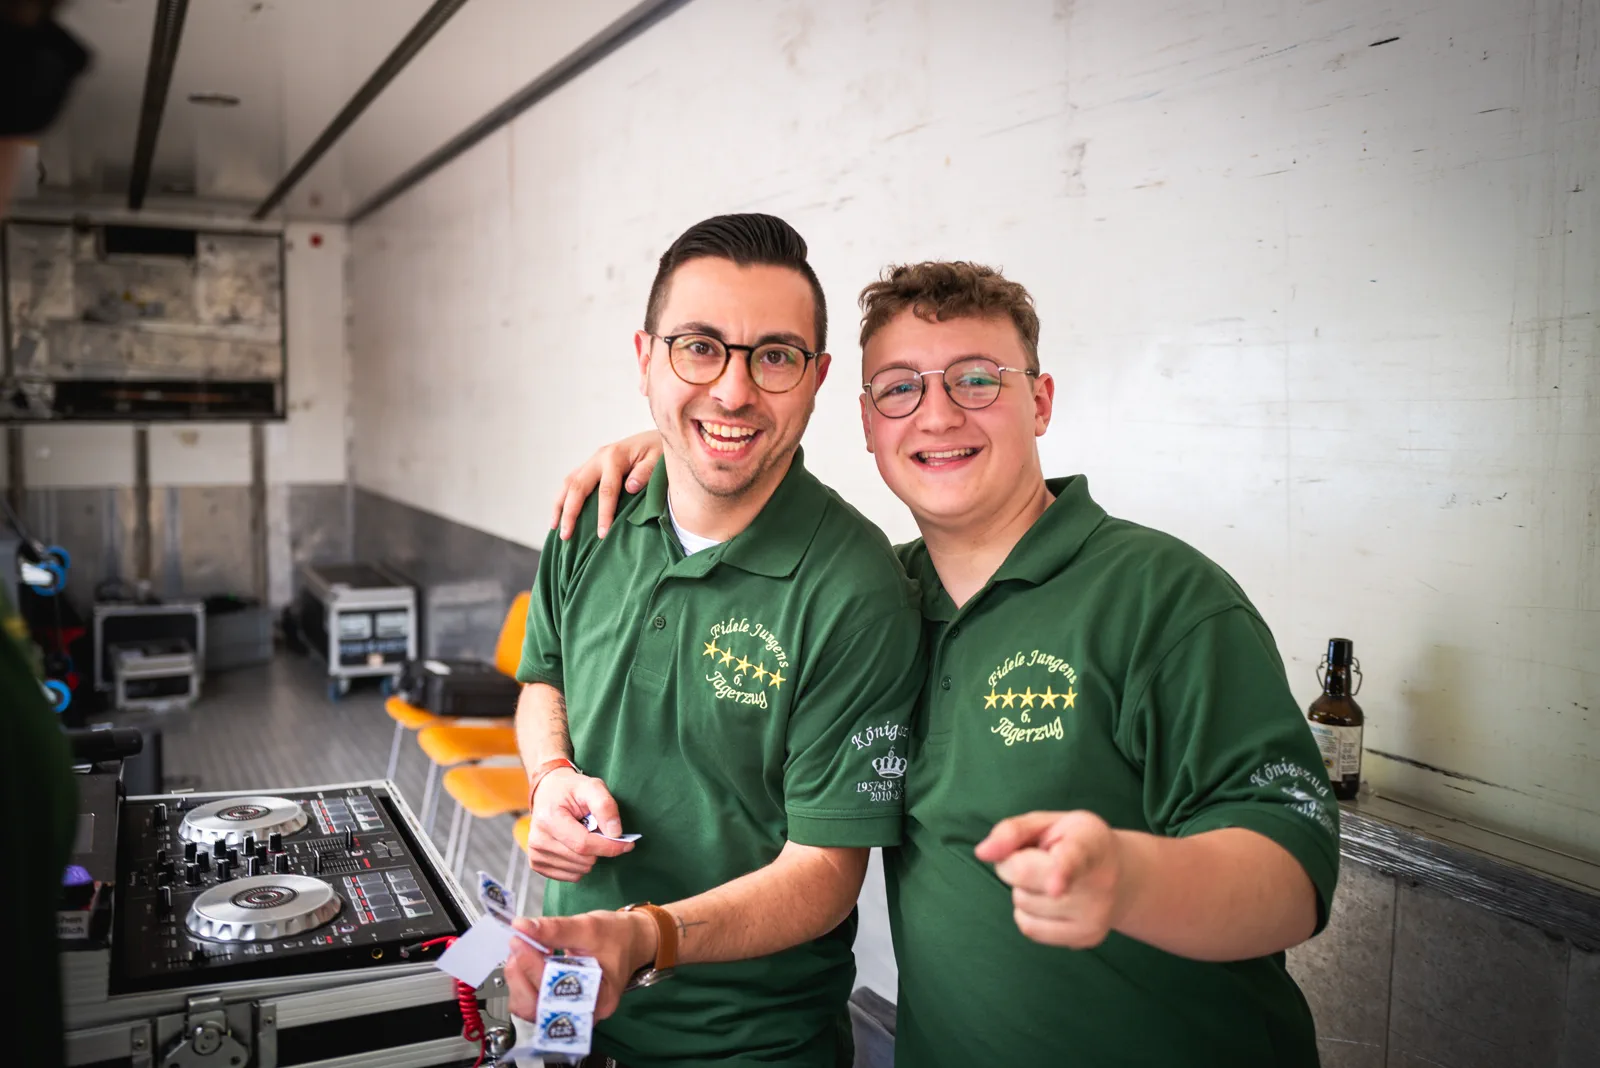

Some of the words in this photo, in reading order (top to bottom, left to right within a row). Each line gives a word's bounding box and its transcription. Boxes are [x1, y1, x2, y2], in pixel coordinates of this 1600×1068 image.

[710, 617, 750, 640] Fidele
[749, 623, 789, 668] Jungens
[733, 673, 743, 686] 6.
[988, 651, 1025, 688] Fidele
[1026, 649, 1077, 685] Jungens
[990, 716, 1064, 746] Jägerzug
[1020, 709, 1031, 723] 6.
